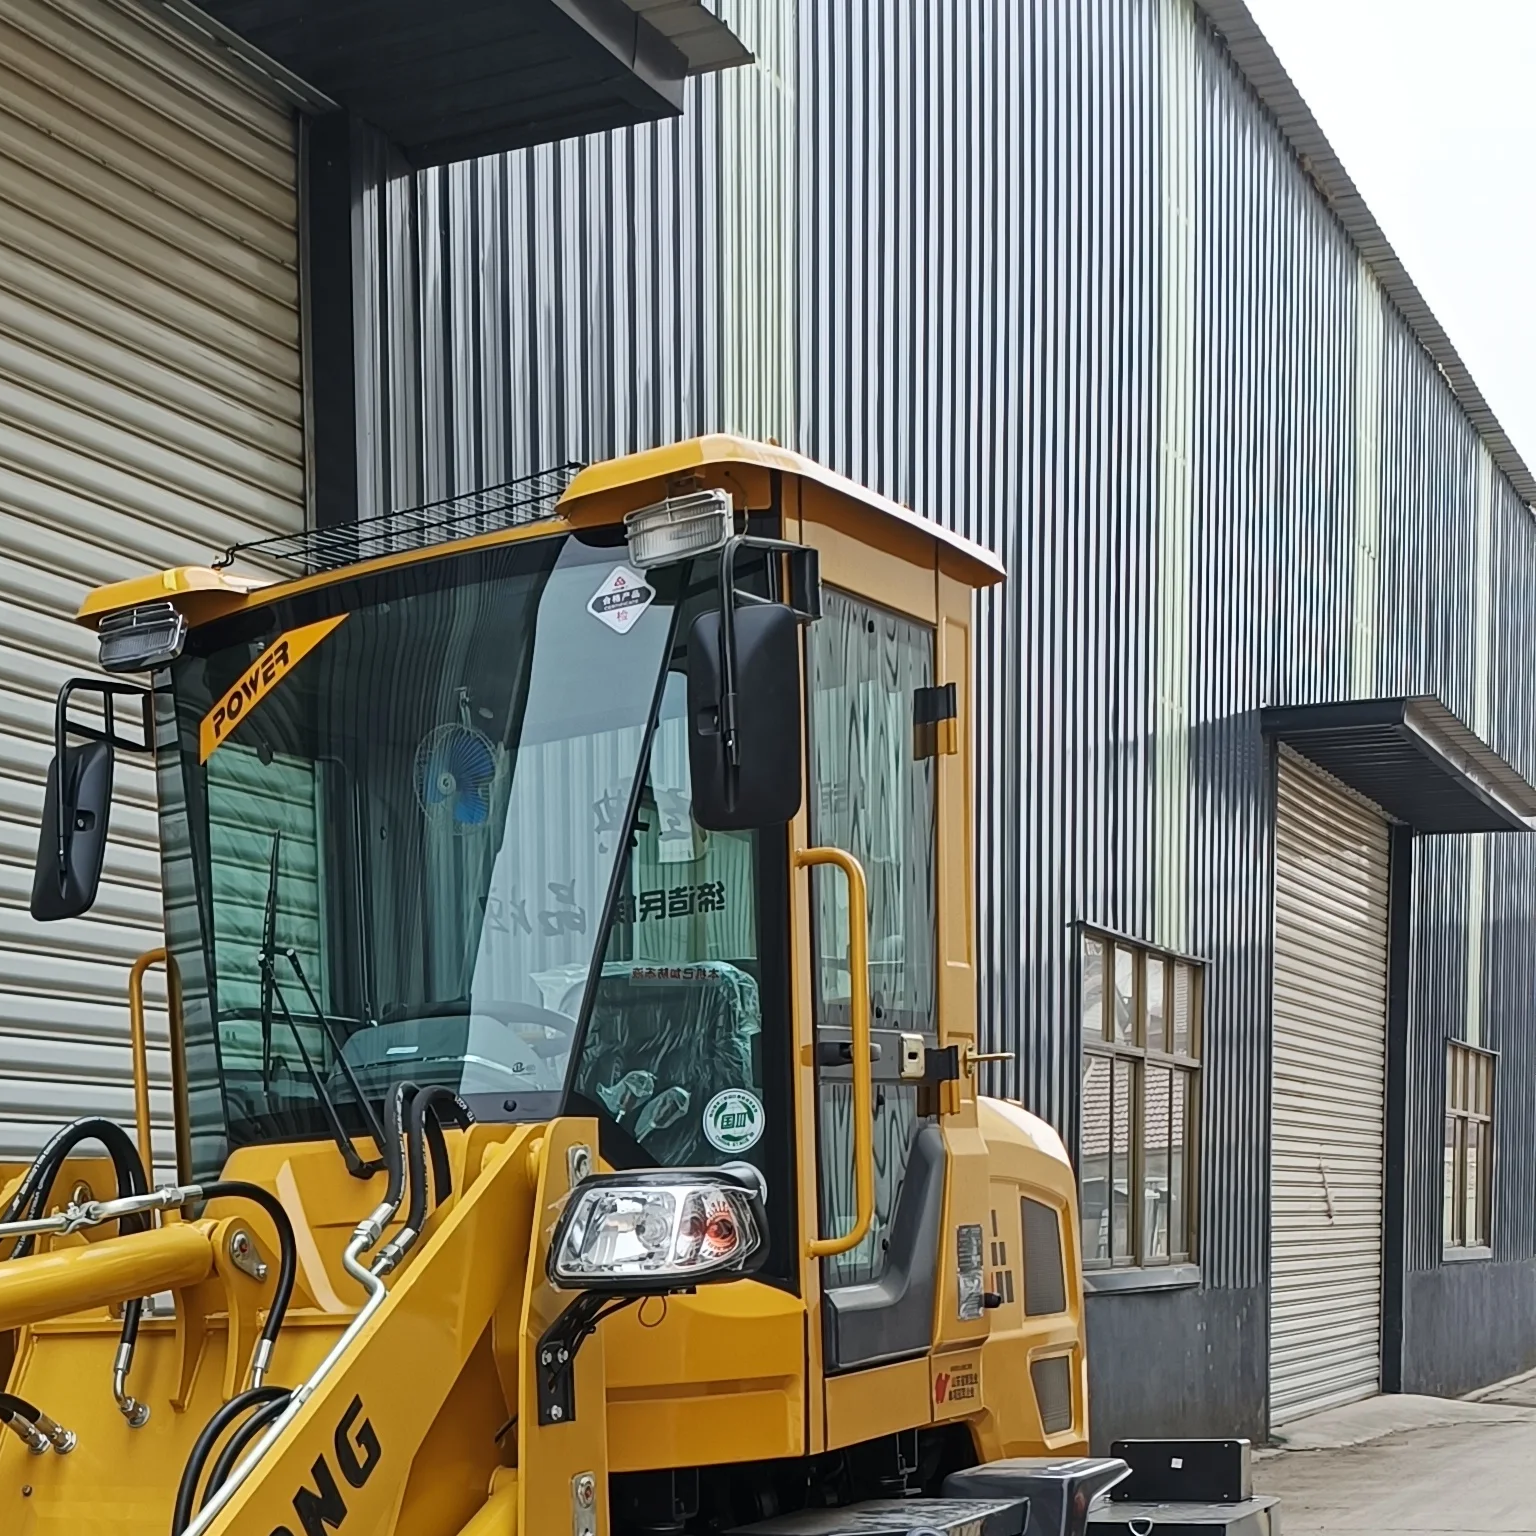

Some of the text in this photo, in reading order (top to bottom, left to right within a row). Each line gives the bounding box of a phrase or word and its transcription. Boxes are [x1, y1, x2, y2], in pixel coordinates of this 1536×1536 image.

[602, 589, 641, 606] 合格产品
[212, 640, 290, 740] POWER
